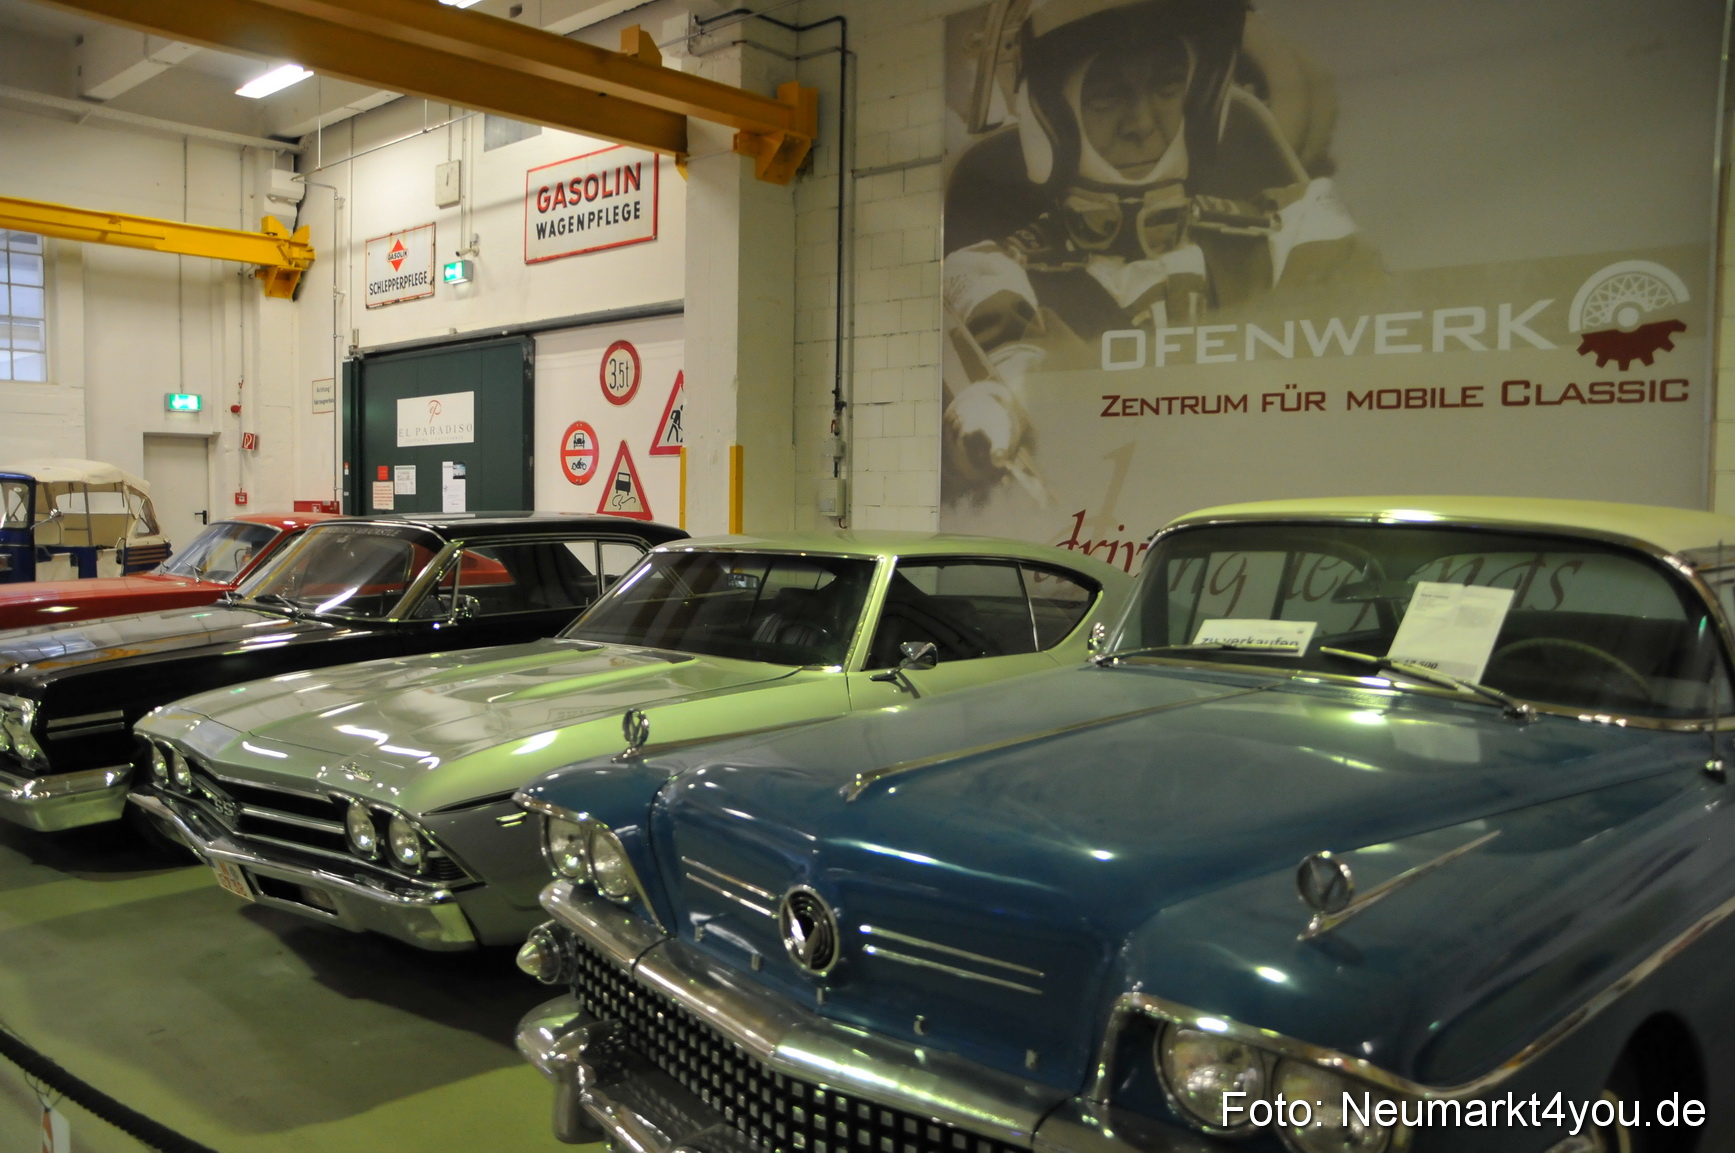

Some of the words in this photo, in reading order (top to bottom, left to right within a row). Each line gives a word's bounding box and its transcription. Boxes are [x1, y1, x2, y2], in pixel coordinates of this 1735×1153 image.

[536, 161, 642, 214] GASOLIN
[536, 200, 641, 241] WAGENPFLEGE
[387, 250, 408, 261] GASOLIN
[369, 270, 428, 296] SCHLEPPERPFLEGE
[1101, 298, 1559, 372] OFENWERK
[1100, 394, 1249, 418] ZENTRUM
[1261, 383, 1327, 413] FÜR
[1346, 386, 1485, 412] MOBILE
[1501, 378, 1690, 407] CLASSIC
[398, 428, 411, 438] EL
[415, 423, 473, 437] PARADISO
[214, 799, 235, 817] SS
